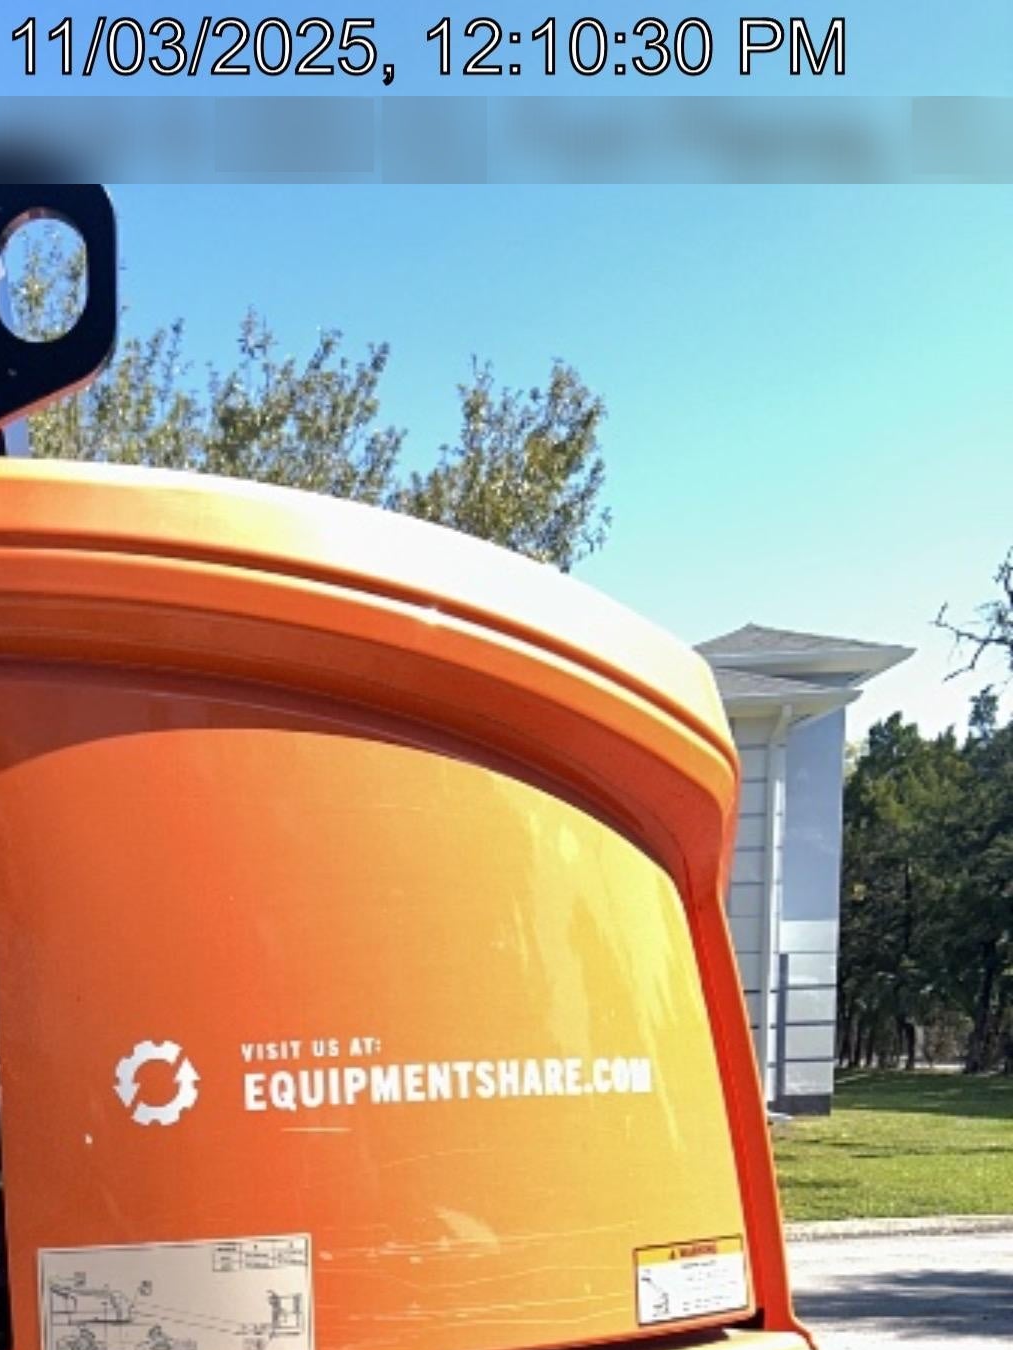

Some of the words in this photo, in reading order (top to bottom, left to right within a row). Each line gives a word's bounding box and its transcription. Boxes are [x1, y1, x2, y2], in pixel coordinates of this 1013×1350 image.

[241, 1042, 301, 1062] VISIT
[312, 1040, 339, 1057] US
[350, 1038, 381, 1056] AT:
[244, 1056, 652, 1111] EQUIPMENTSHARE.COM
